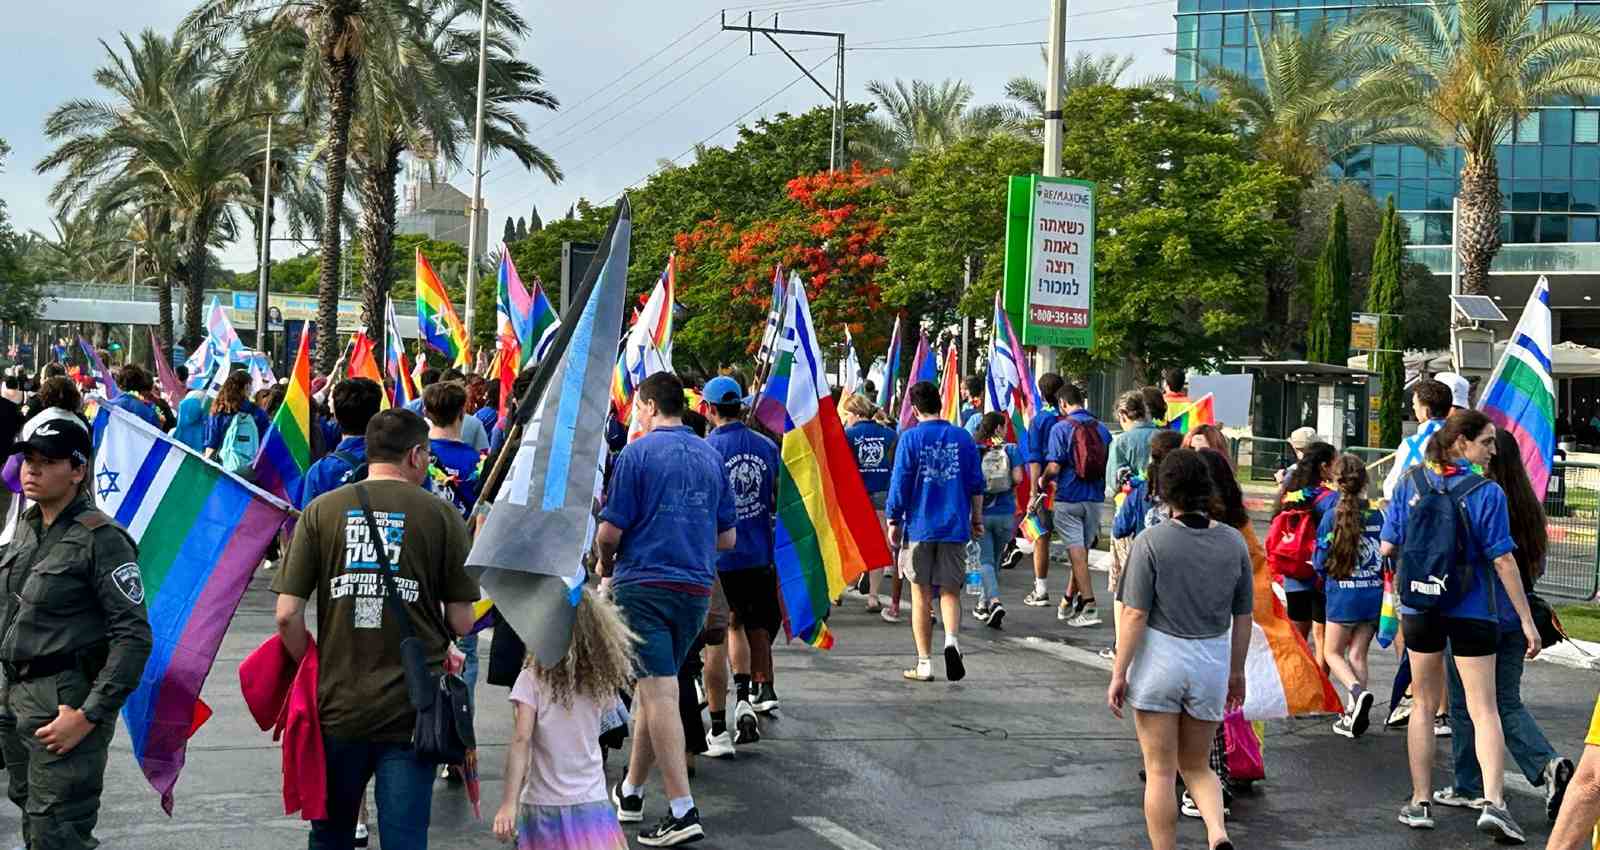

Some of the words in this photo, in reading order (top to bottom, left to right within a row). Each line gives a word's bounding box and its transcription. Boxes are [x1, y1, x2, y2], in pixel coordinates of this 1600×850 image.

[1040, 218, 1084, 235] כשאתה
[1043, 239, 1078, 255] באמת
[1046, 259, 1074, 274] רוצה
[1039, 278, 1079, 296] למכור!
[356, 584, 378, 596] את
